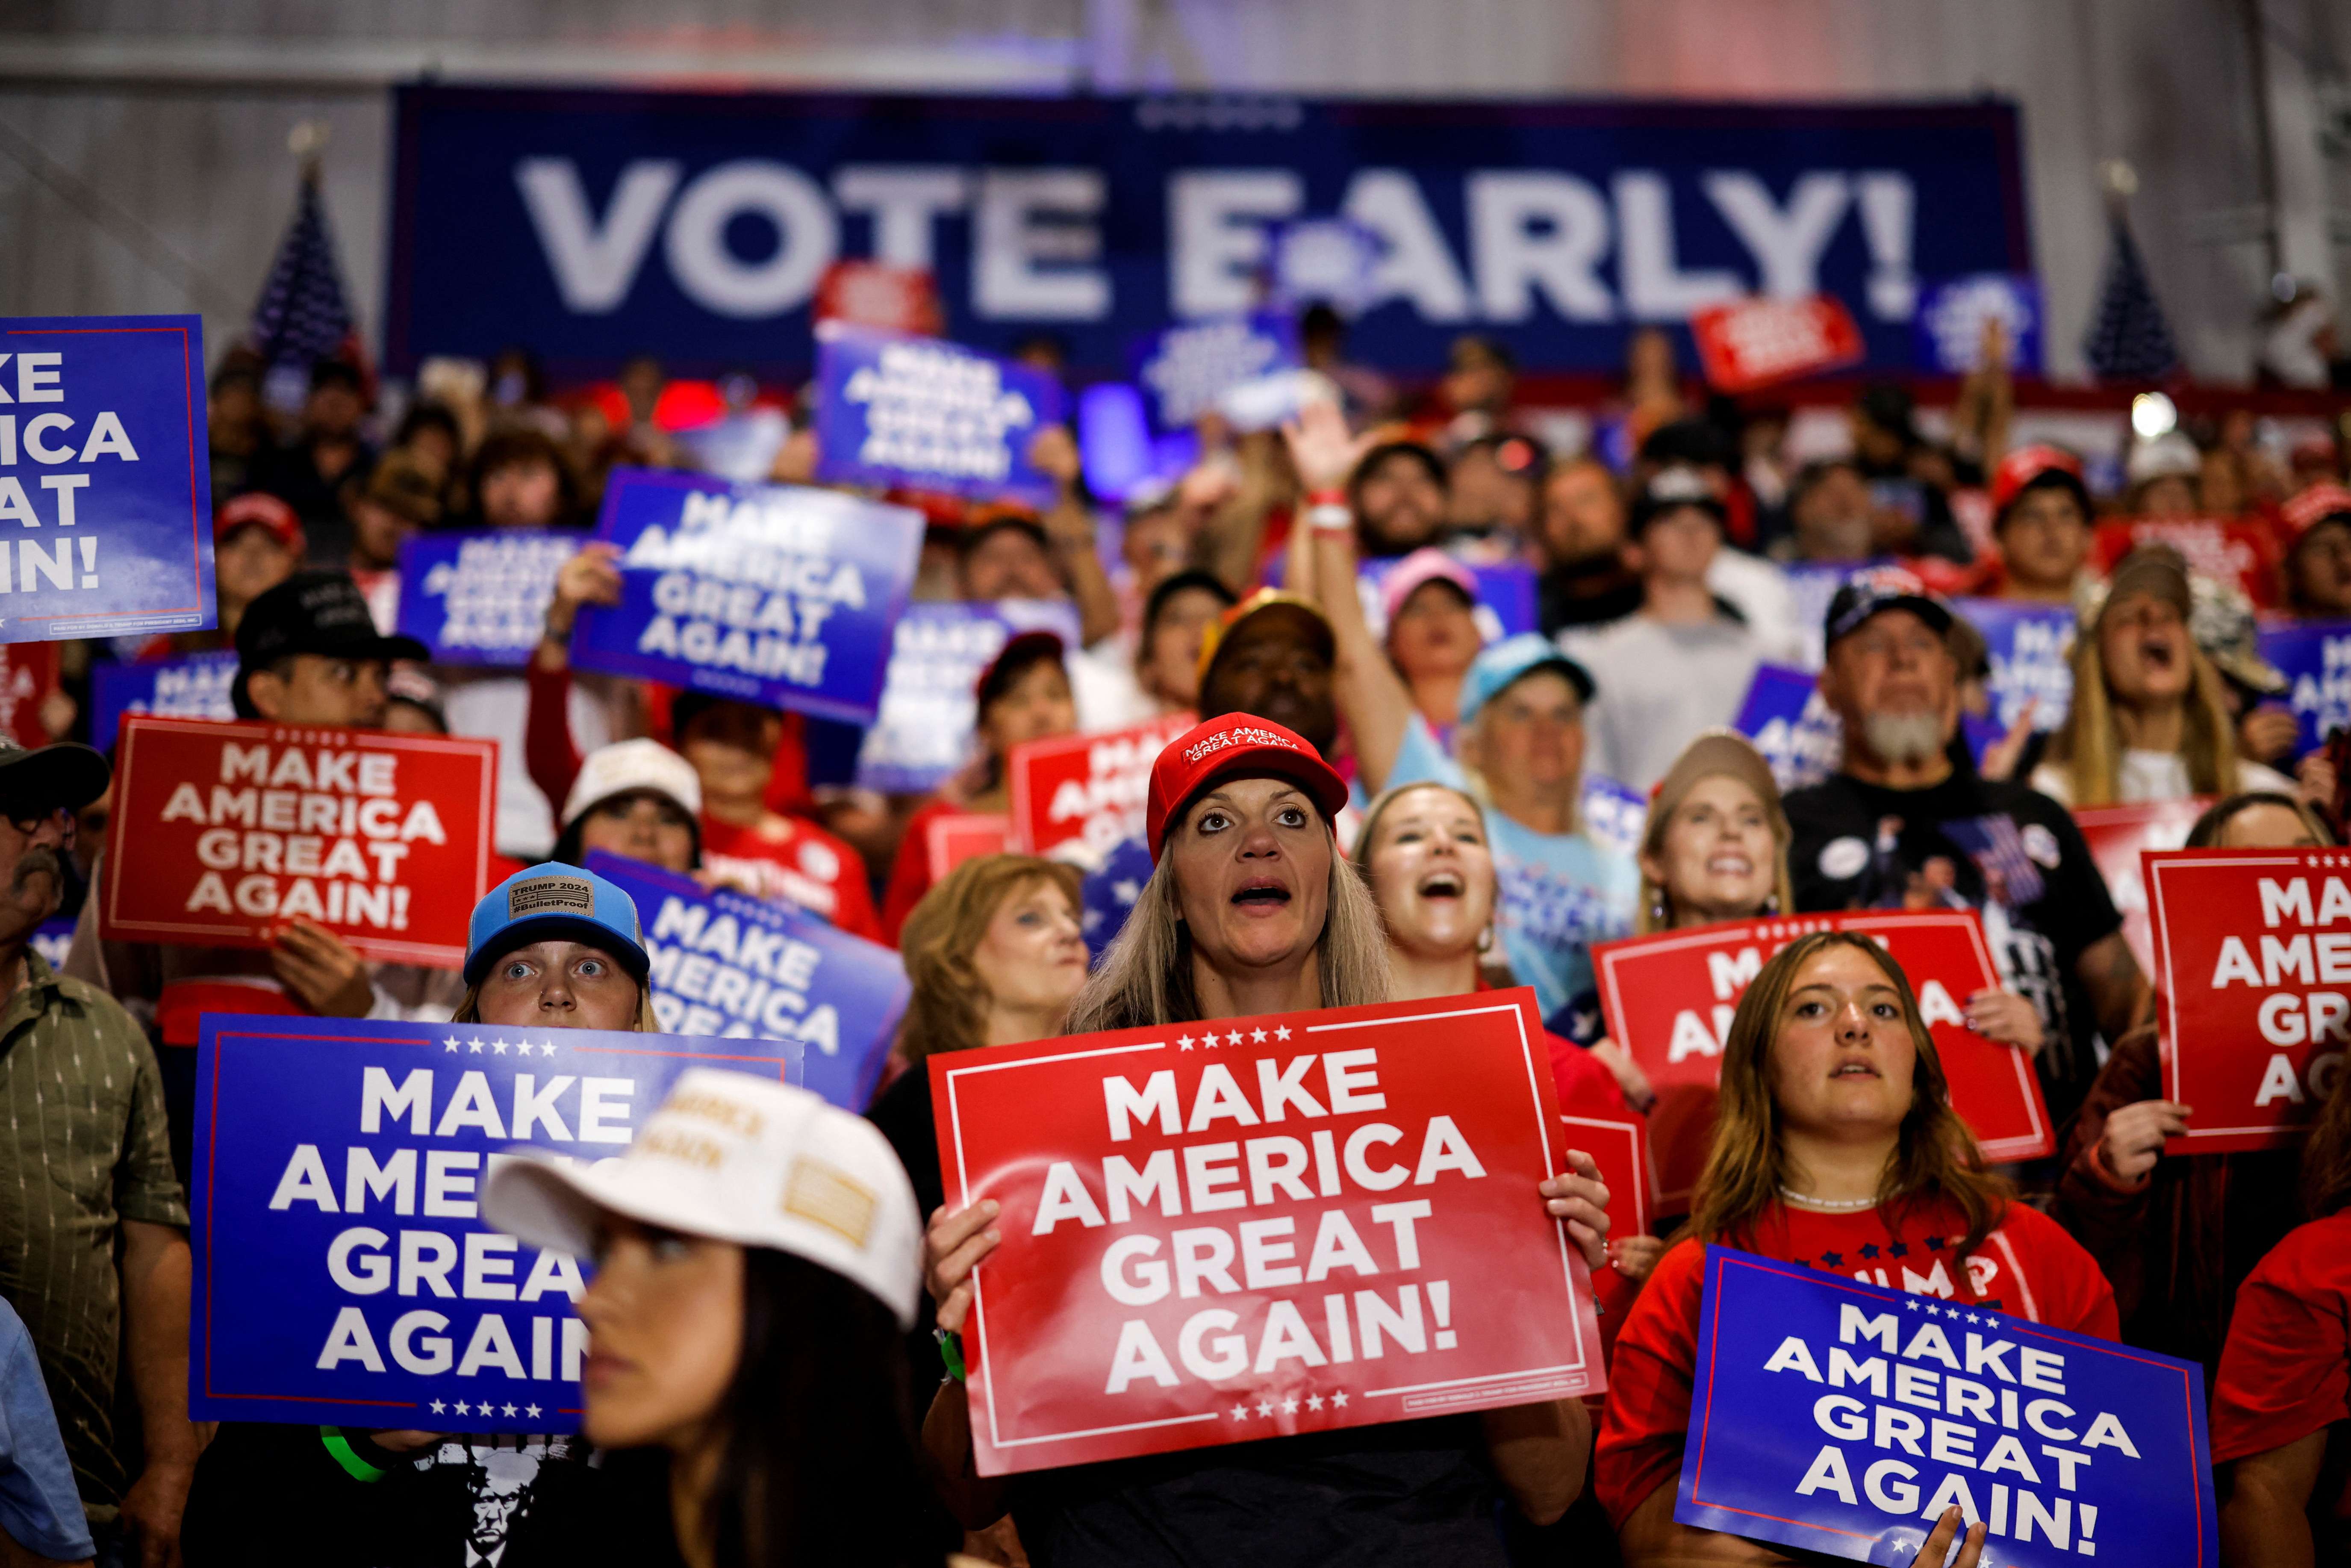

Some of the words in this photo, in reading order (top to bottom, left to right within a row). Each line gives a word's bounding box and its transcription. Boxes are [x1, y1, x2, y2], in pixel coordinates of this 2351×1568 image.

[514, 156, 1112, 318] VOTE
[1169, 168, 1917, 321] EARLY!
[652, 571, 832, 639] GREAT
[639, 614, 827, 687] AGAIN!
[220, 741, 398, 796] MAKE
[1185, 731, 1228, 757] MAKE
[1232, 727, 1299, 749] AMERICA
[1192, 736, 1241, 761] GREAT
[161, 781, 447, 845] AMERICA
[196, 828, 410, 883] GREAT
[513, 883, 556, 896] TRUMP
[560, 883, 589, 892] 2024
[186, 869, 411, 931] AGAIN!
[513, 899, 588, 913] #BulletProof
[653, 896, 821, 992] MAKE
[645, 937, 840, 1056] MERICA
[360, 1066, 636, 1144] MAKE
[1102, 1047, 1386, 1142] MAKE
[1031, 1115, 1488, 1236] AMERICA
[327, 1226, 589, 1303] GREA
[1101, 1199, 1432, 1307] GREAT
[1105, 1279, 1458, 1395] AGAIN!
[1838, 1303, 2065, 1395] MAKE
[1762, 1335, 2142, 1459] AMERICA
[1812, 1394, 2092, 1492] GREAT
[1794, 1445, 2098, 1557] AGAIN!
